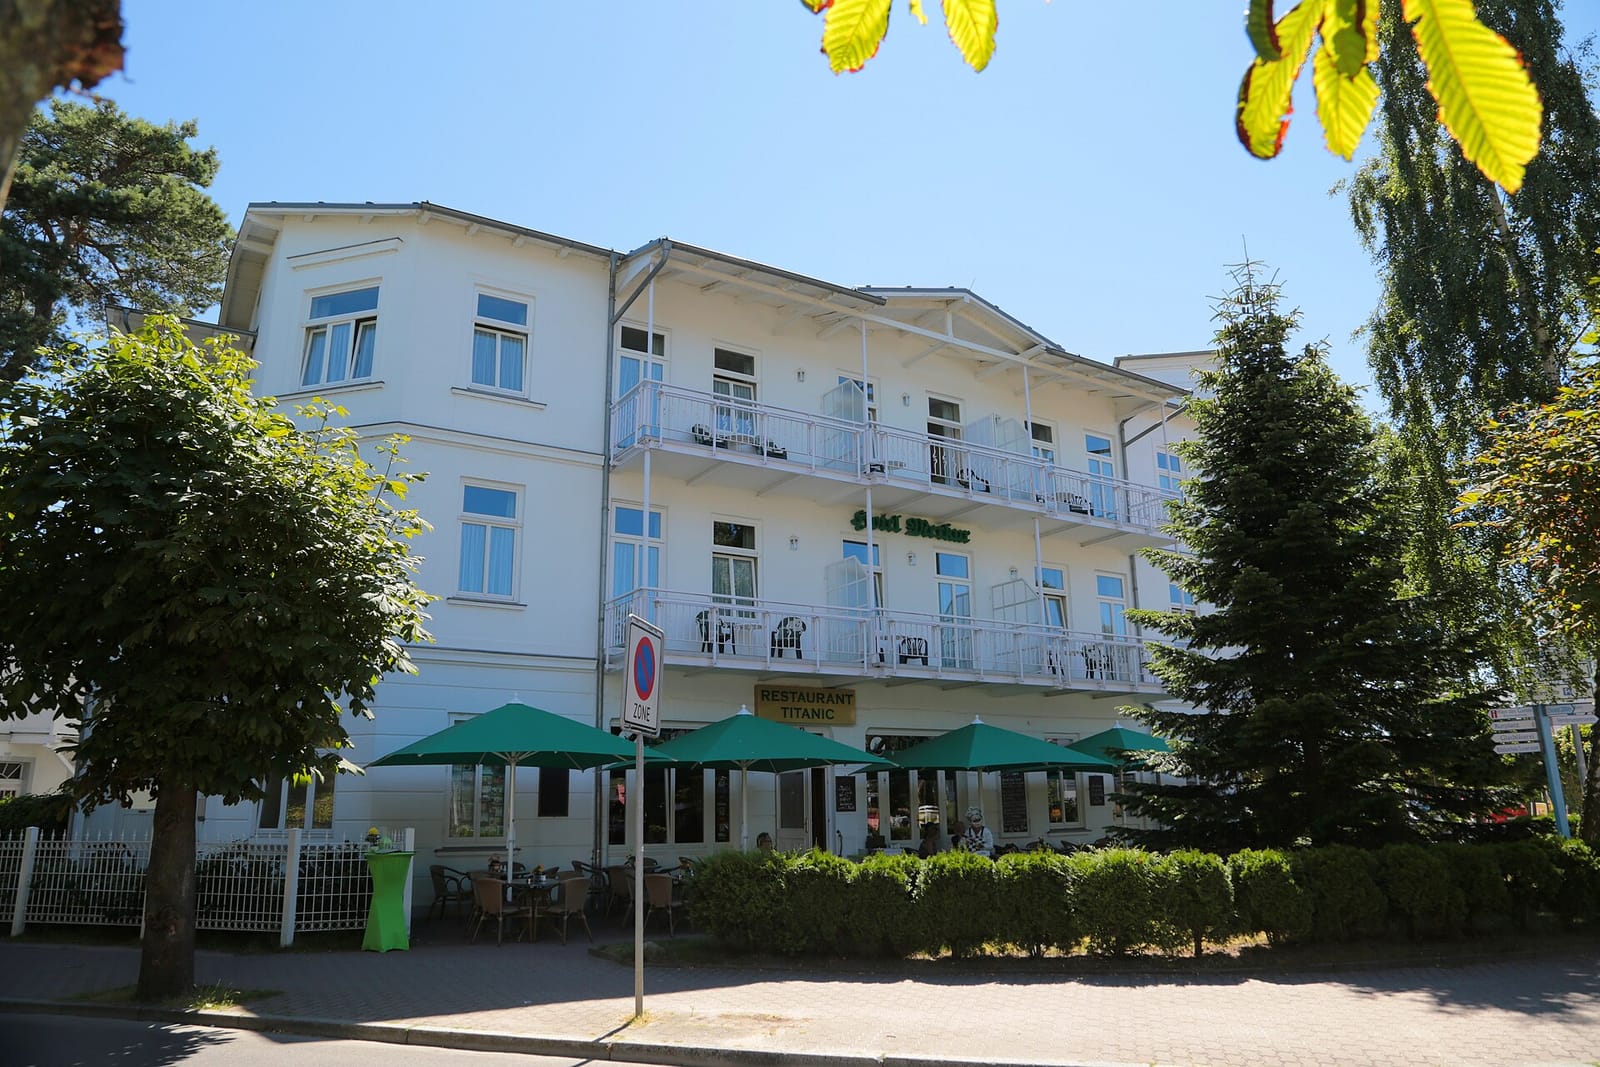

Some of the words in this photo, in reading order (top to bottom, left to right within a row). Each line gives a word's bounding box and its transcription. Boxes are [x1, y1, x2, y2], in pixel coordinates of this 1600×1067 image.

[761, 689, 854, 705] RESTAURANT
[633, 702, 651, 722] ZONE
[781, 706, 835, 720] TITANIC
